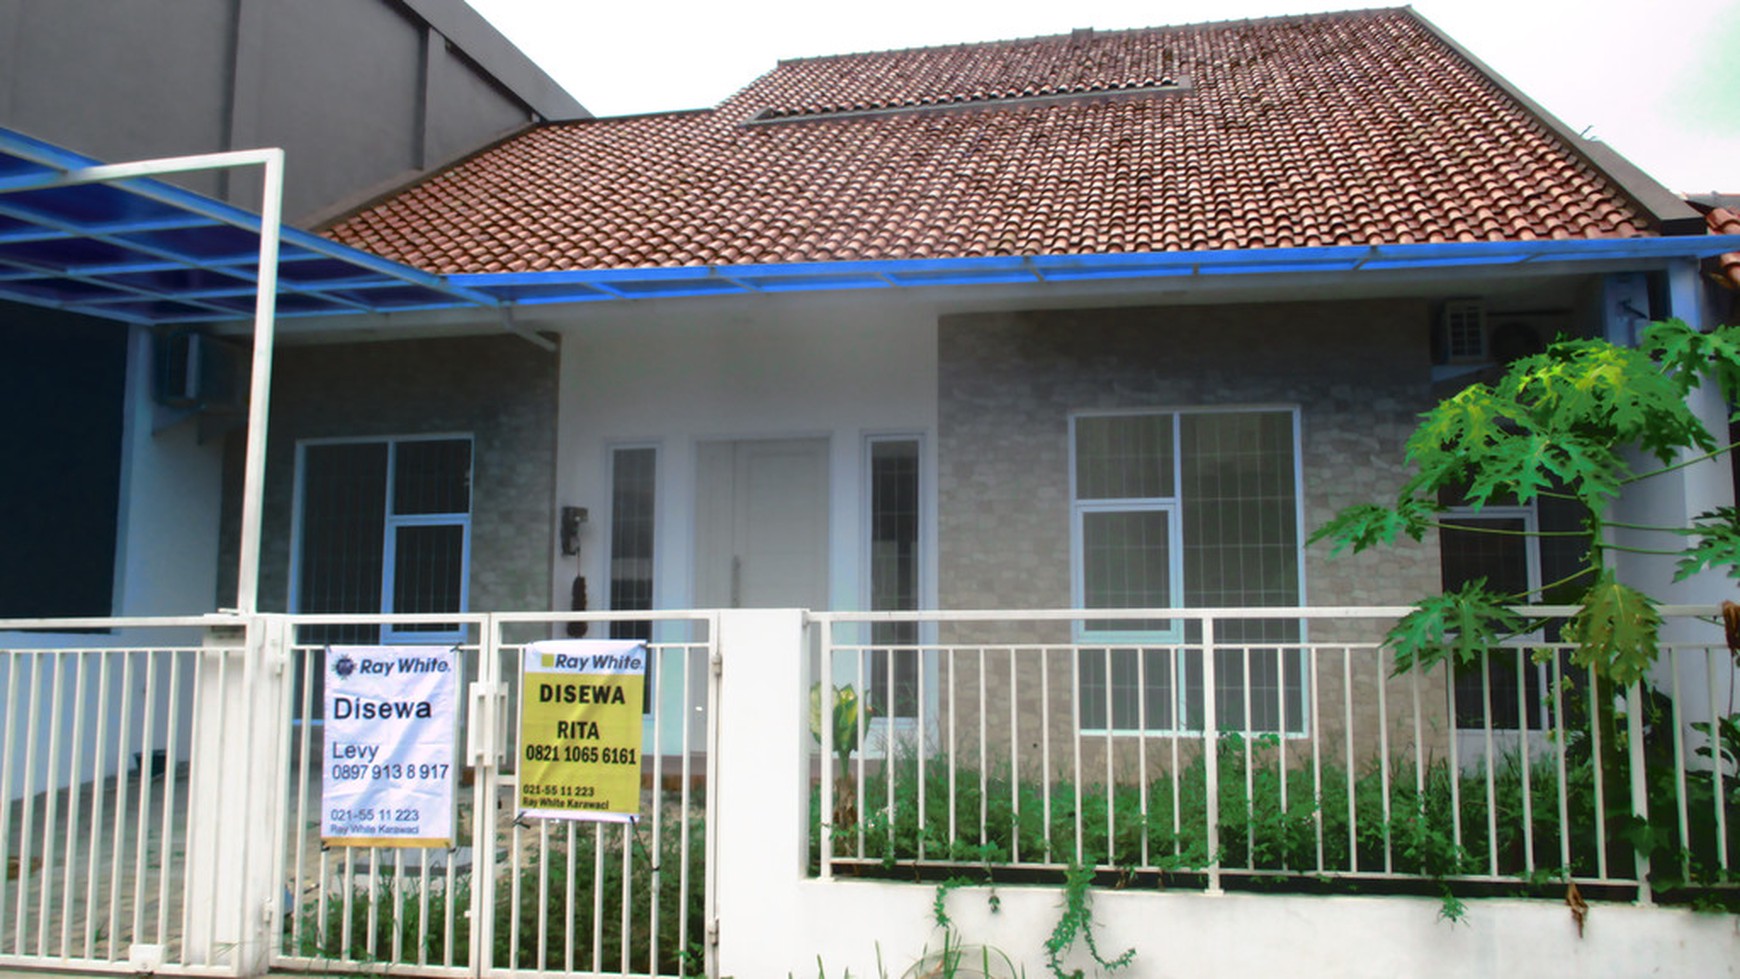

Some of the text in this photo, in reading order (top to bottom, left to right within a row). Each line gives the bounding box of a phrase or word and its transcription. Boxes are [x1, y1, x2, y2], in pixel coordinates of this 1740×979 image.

[359, 658, 394, 677] Ray
[555, 654, 589, 671] Ray
[540, 684, 625, 705] DISEWA
[334, 697, 432, 719] Disewa
[557, 721, 600, 740] RITA
[332, 742, 379, 763] Levy
[526, 744, 637, 765] 0821 1065 6161
[331, 764, 449, 780] 0897 913 8 917
[523, 784, 595, 797] 021-55 11 223
[522, 797, 539, 808] Ray
[540, 798, 565, 808] White
[330, 809, 420, 822] 021-55 11 223
[330, 825, 349, 835] Ray
[351, 824, 376, 834] White
